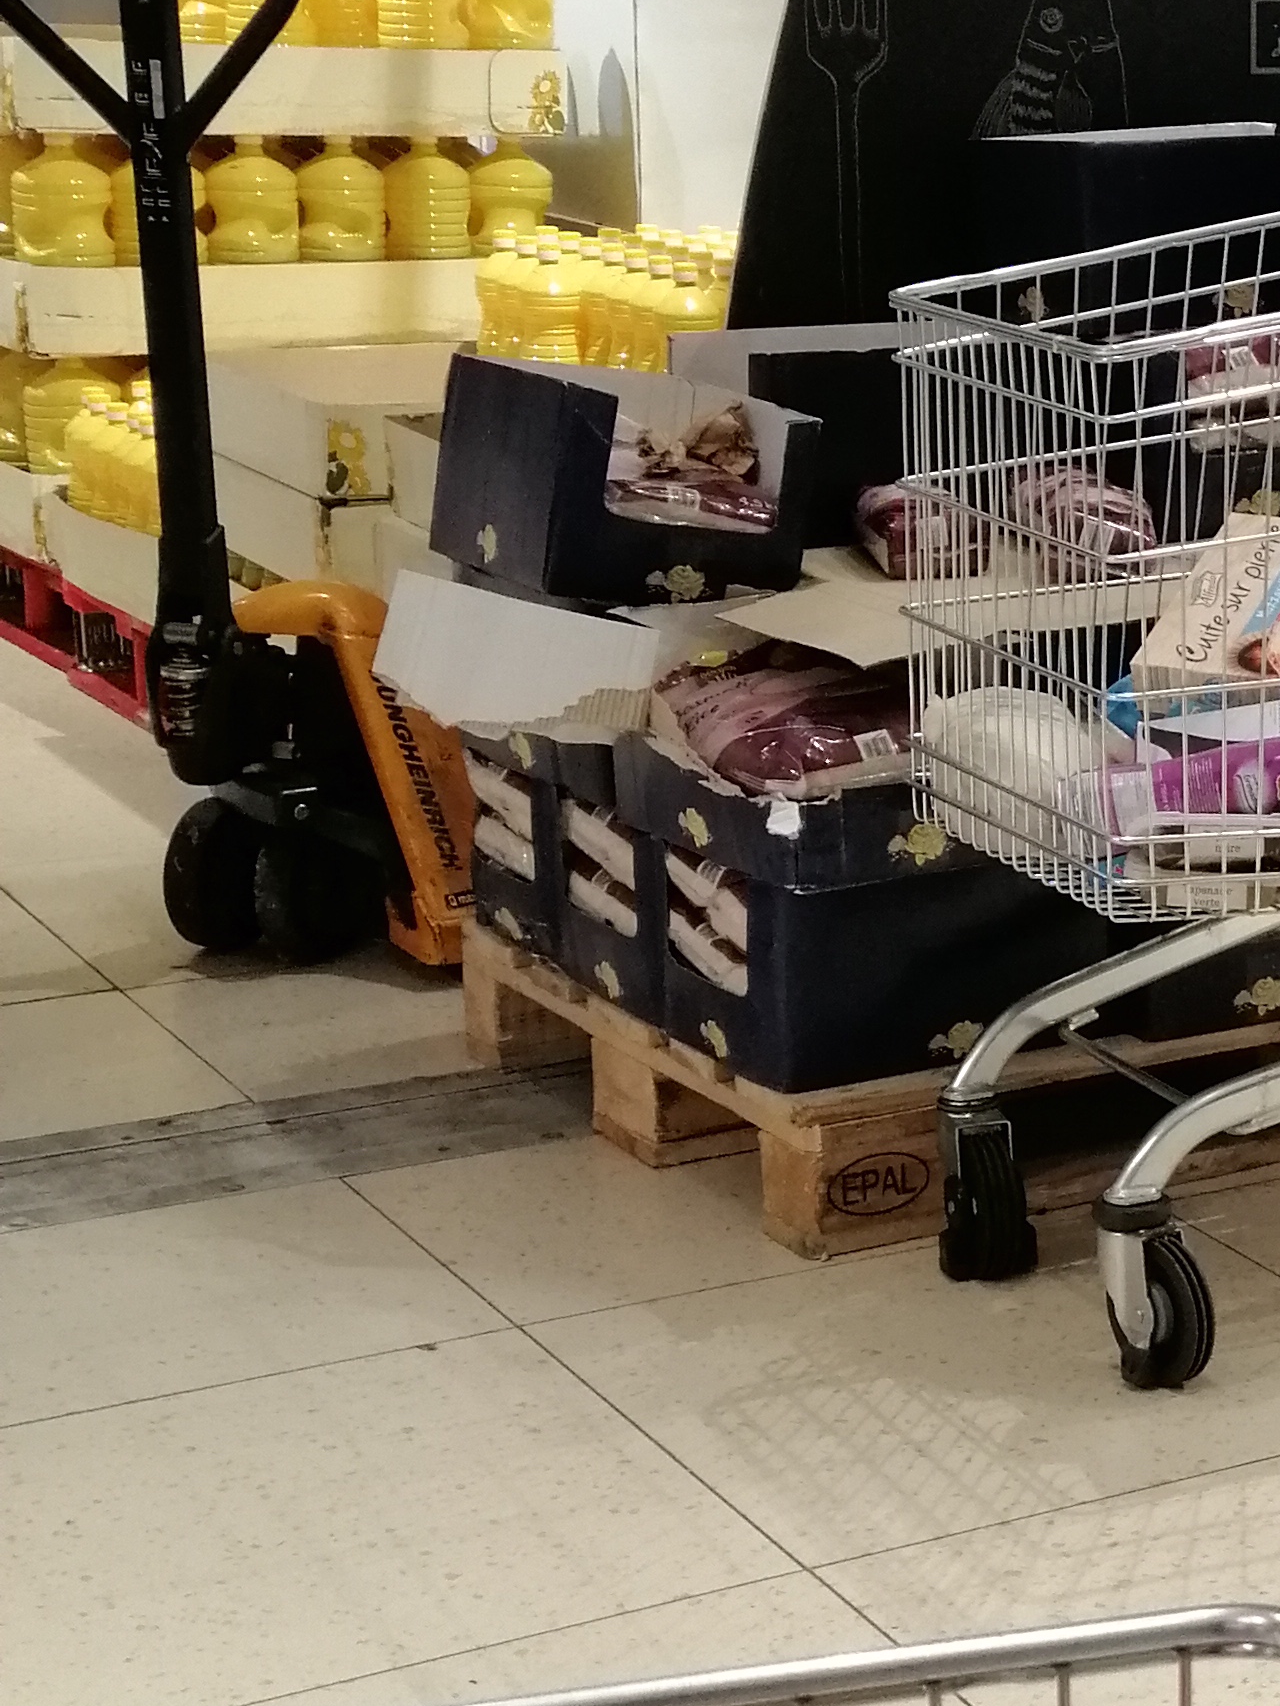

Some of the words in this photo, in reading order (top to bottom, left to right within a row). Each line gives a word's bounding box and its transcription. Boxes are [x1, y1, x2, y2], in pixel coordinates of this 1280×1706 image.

[1224, 583, 1251, 613] sur
[370, 669, 463, 871] UNGHEINRICH
[842, 1163, 918, 1206] EPAL
